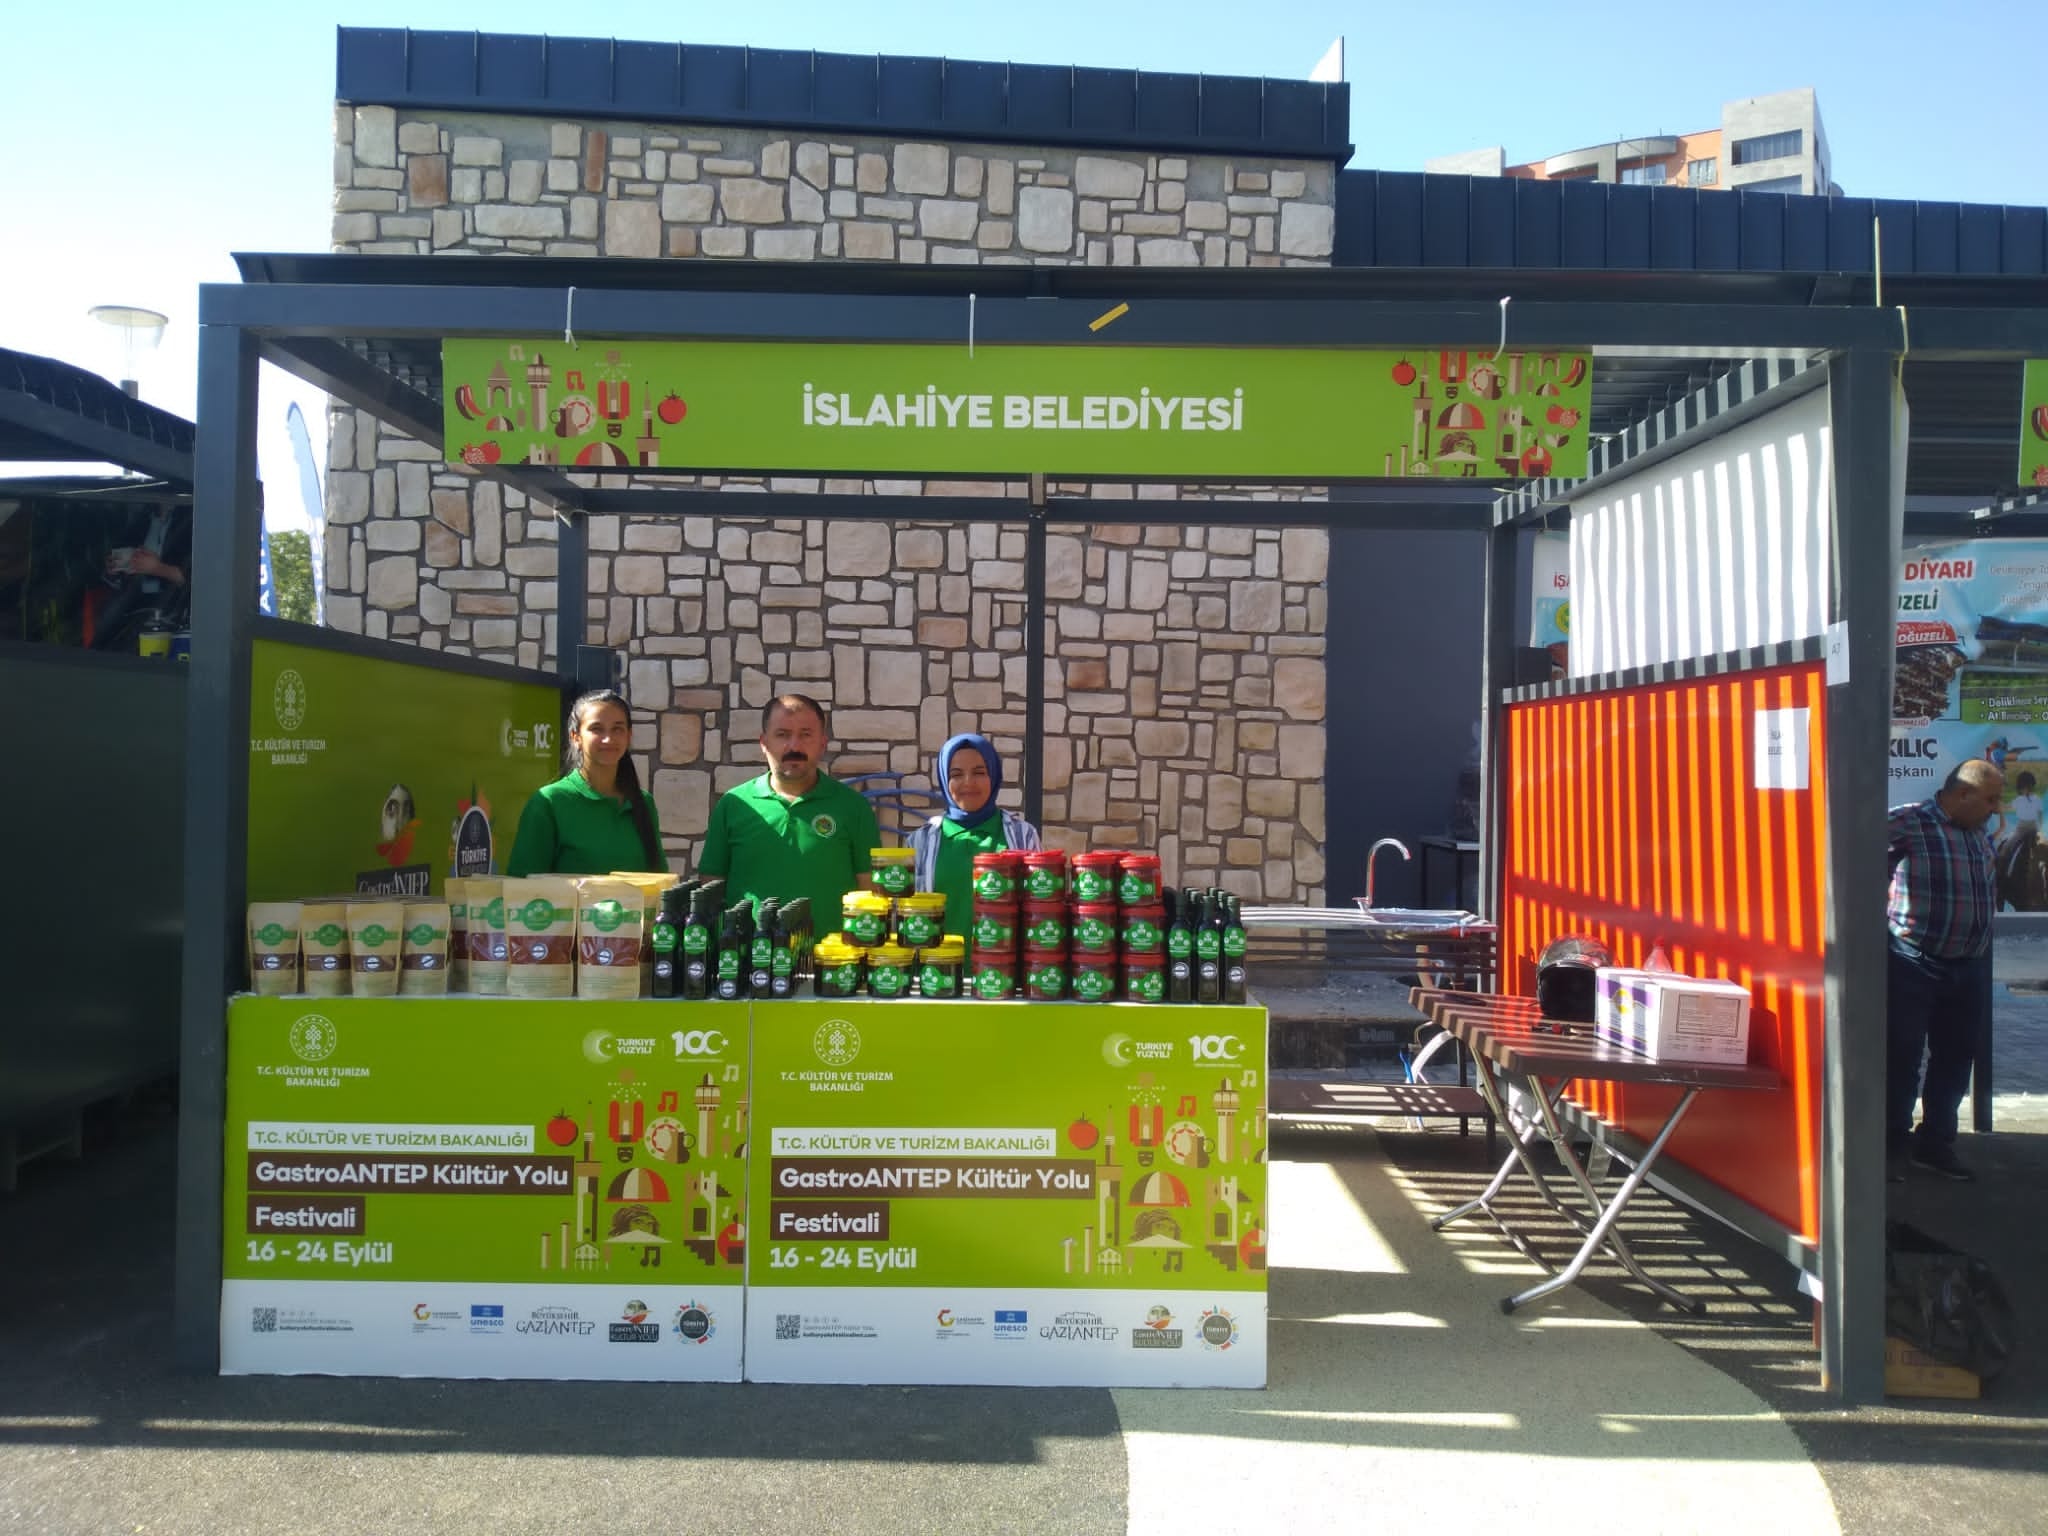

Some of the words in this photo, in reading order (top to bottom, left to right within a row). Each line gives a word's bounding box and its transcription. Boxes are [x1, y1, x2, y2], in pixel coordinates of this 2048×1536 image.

[803, 383, 993, 428] İSLAHİYE
[1003, 387, 1244, 431] BELEDİYESİ
[1905, 557, 1974, 581] DİYARI
[256, 1066, 274, 1075] T.C.
[275, 1065, 314, 1076] KÜLTÜR
[316, 1067, 329, 1076] VE
[781, 1072, 798, 1081] T.C.
[799, 1070, 838, 1081] KÜLTÜR
[840, 1072, 853, 1081] VE
[855, 1070, 894, 1081] TURİZM
[286, 1077, 340, 1088] BAKANLIĞI
[809, 1081, 864, 1092] BAKANLIĞI
[255, 1131, 282, 1144] T.C.
[286, 1129, 347, 1145] KÜLTÜR
[351, 1134, 372, 1145] VE
[376, 1131, 436, 1146] TURİZM
[440, 1131, 528, 1147] BAKANLIĞI
[778, 1137, 806, 1150] T.C.
[809, 1134, 872, 1149] KÜLTÜR
[876, 1138, 896, 1149] VE
[901, 1135, 960, 1150] TURİZM
[964, 1135, 1050, 1151] BAKANLIĞI
[255, 1161, 428, 1184] GastroANTEP
[433, 1163, 508, 1185] Kültür
[513, 1165, 568, 1186] Yolu
[779, 1167, 950, 1189] GastroANTEP
[956, 1167, 1032, 1189] Kültür
[1036, 1168, 1090, 1190] Yolu
[255, 1205, 356, 1228] Festivali
[779, 1212, 880, 1233] Festivali
[246, 1240, 276, 1262] 16
[296, 1240, 328, 1262] 24
[332, 1241, 393, 1267] Eylül
[770, 1247, 799, 1268] 16
[820, 1247, 851, 1268] 24
[857, 1247, 917, 1273] Eylül
[470, 1319, 504, 1327] unesco
[994, 1324, 1028, 1333] unesco
